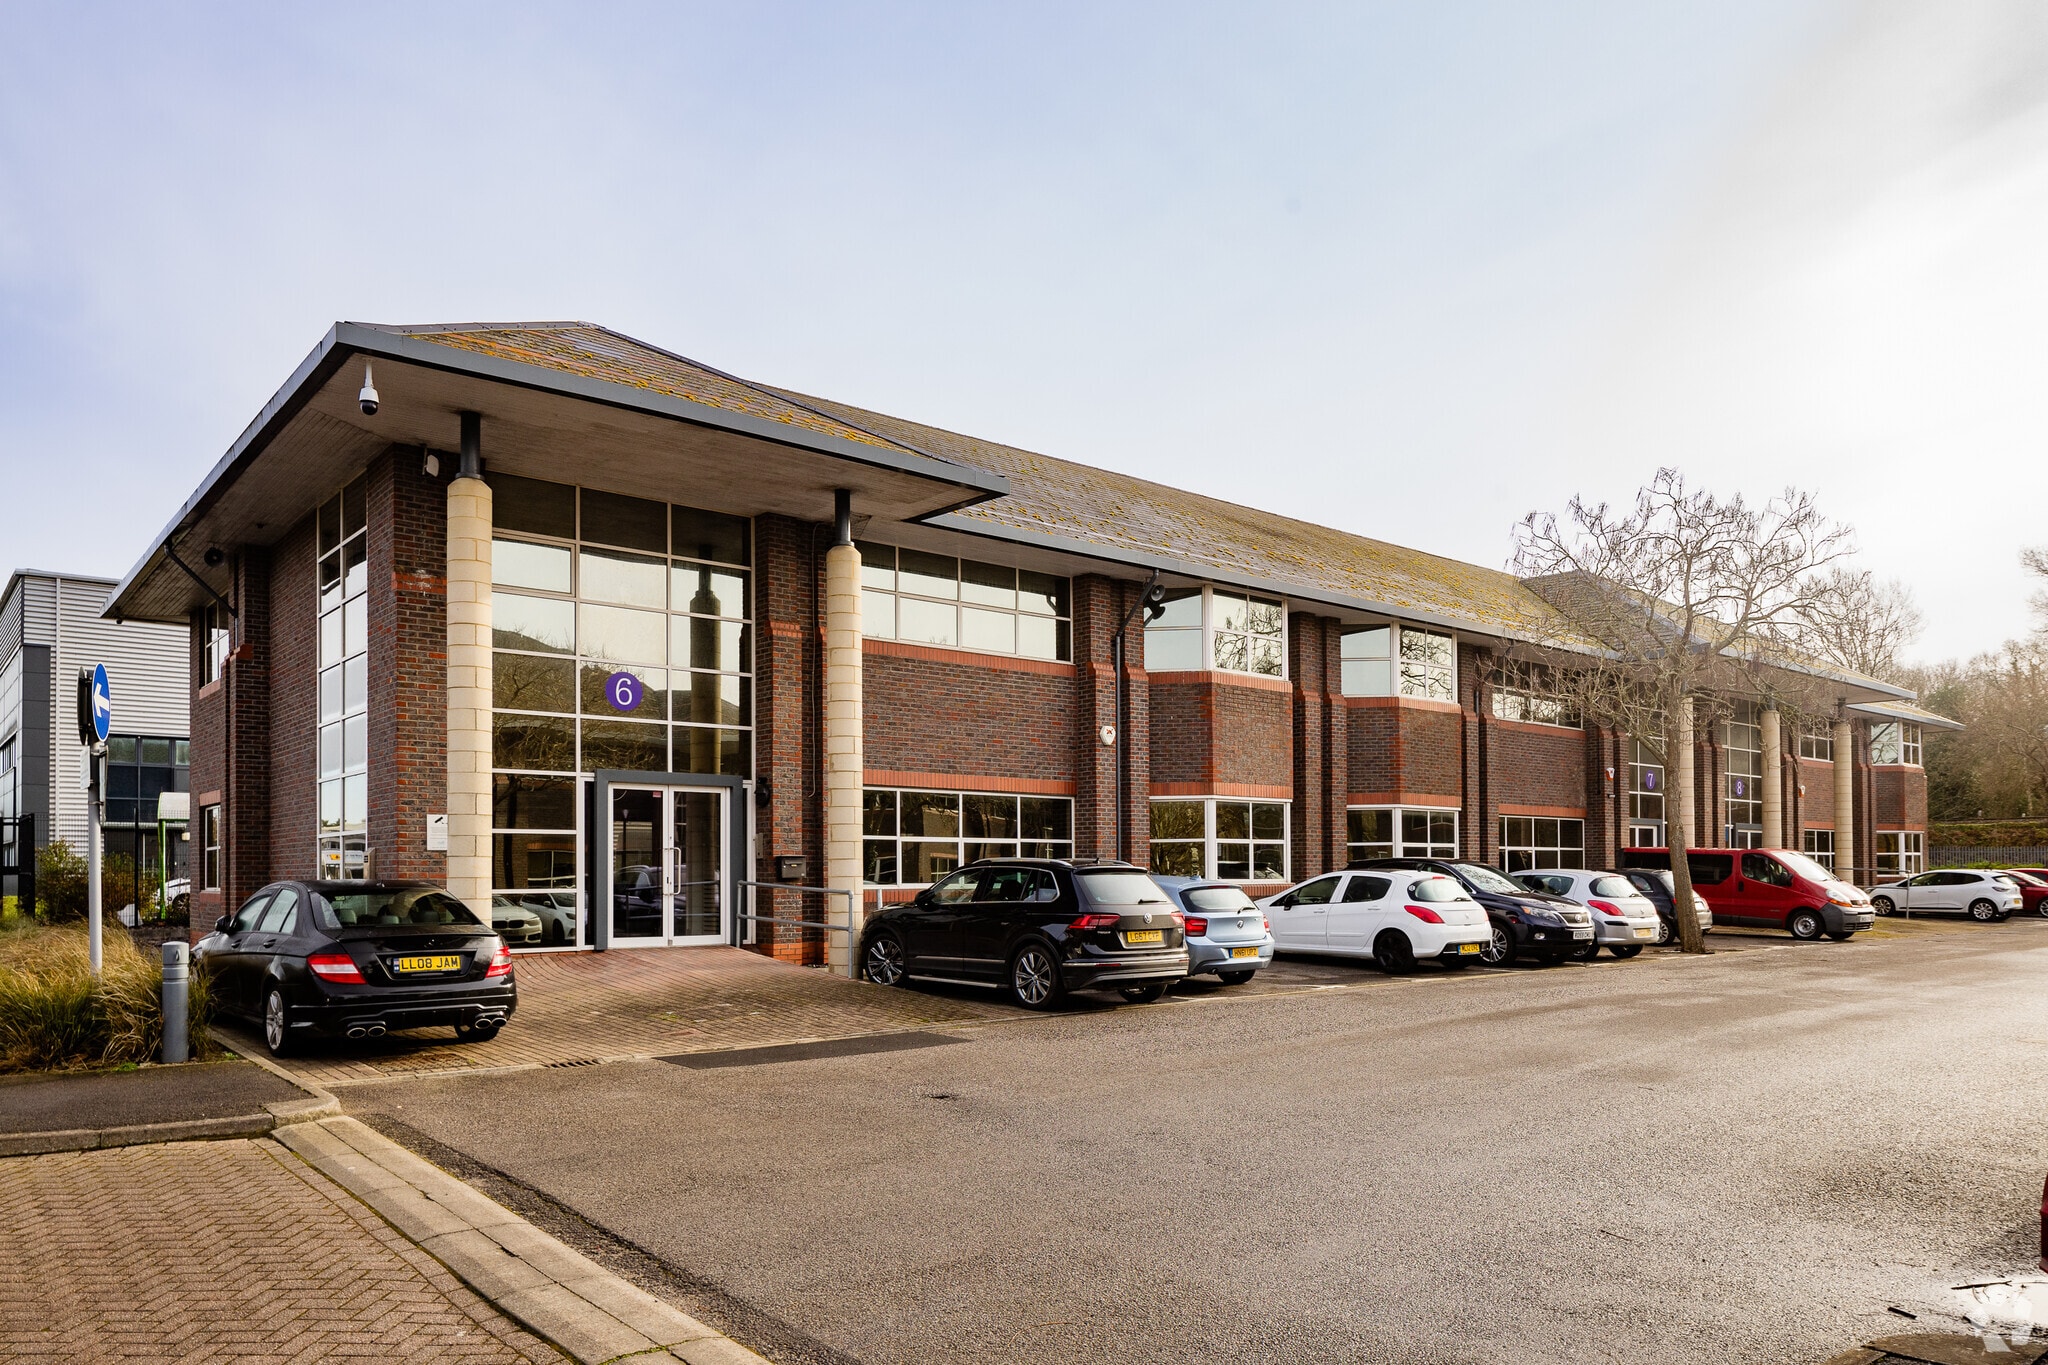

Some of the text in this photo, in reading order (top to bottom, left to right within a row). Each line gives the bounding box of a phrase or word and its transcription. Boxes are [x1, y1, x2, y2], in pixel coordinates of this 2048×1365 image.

[615, 677, 633, 706] 6
[1647, 773, 1654, 787] 7
[401, 957, 459, 970] LL08 JAM
